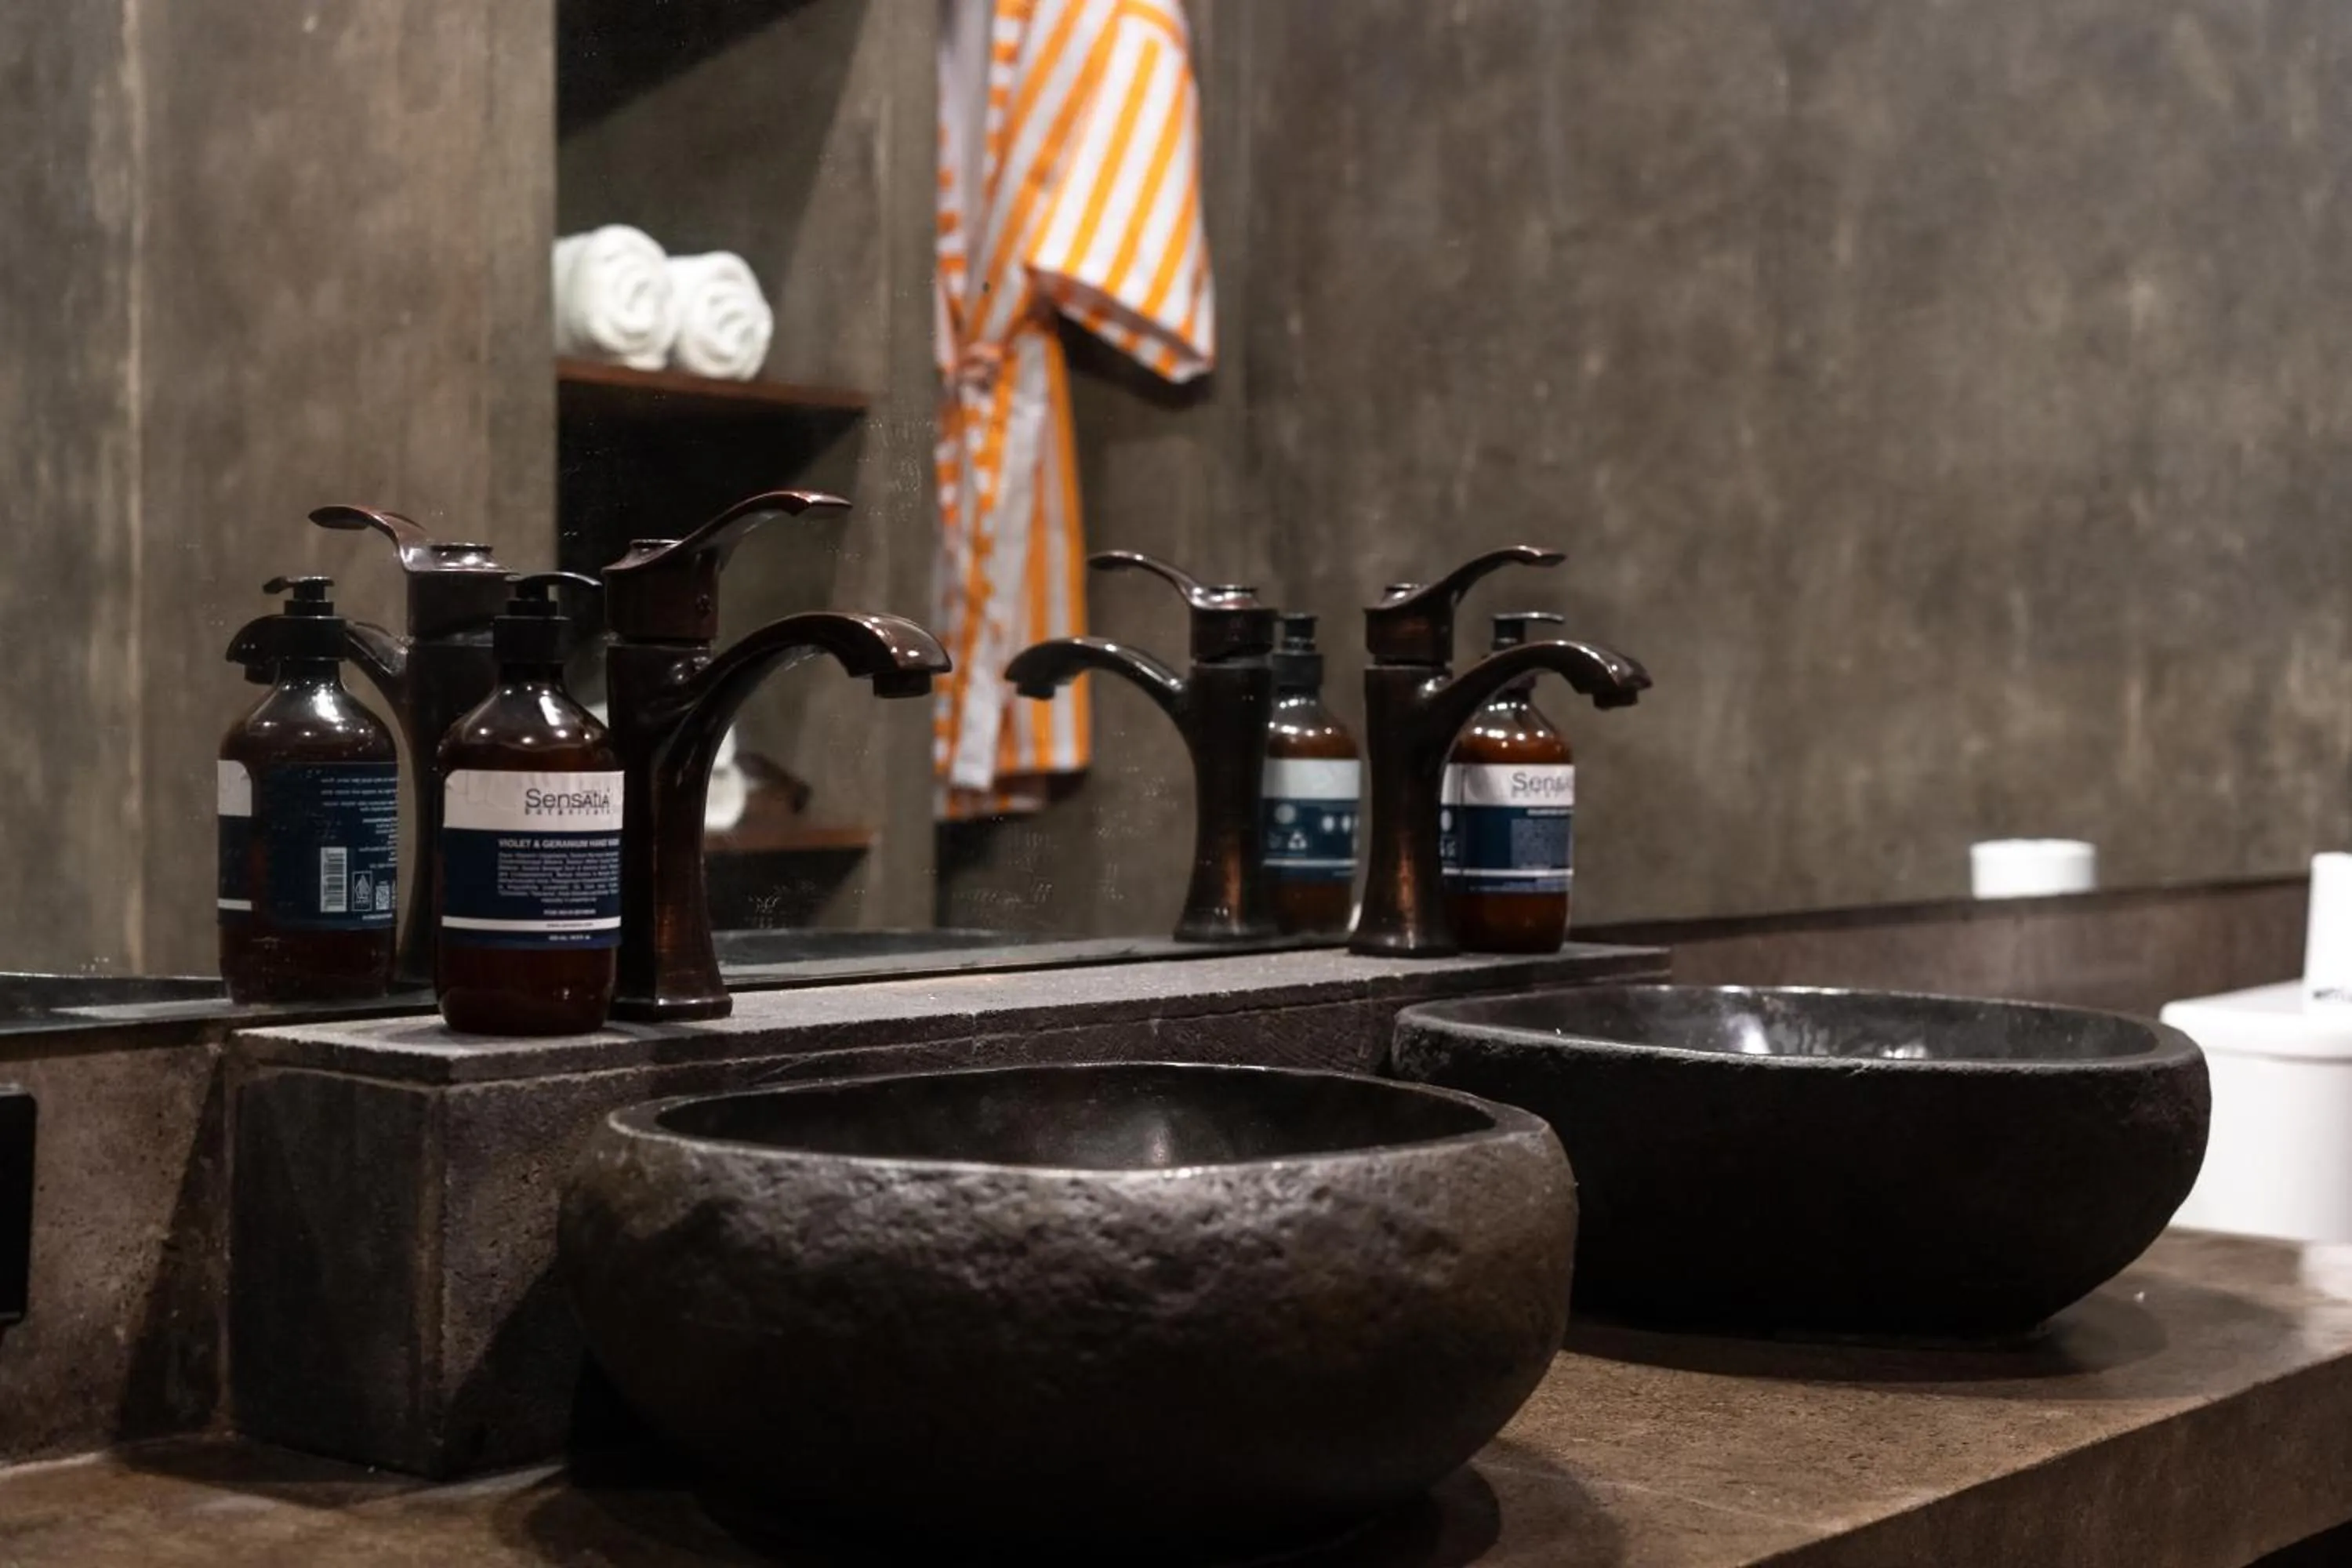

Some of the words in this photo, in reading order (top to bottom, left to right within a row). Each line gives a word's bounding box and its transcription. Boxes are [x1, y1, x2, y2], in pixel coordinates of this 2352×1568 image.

[498, 839, 532, 848] VIOLET
[533, 840, 541, 848] &
[542, 839, 588, 848] GERANIUM
